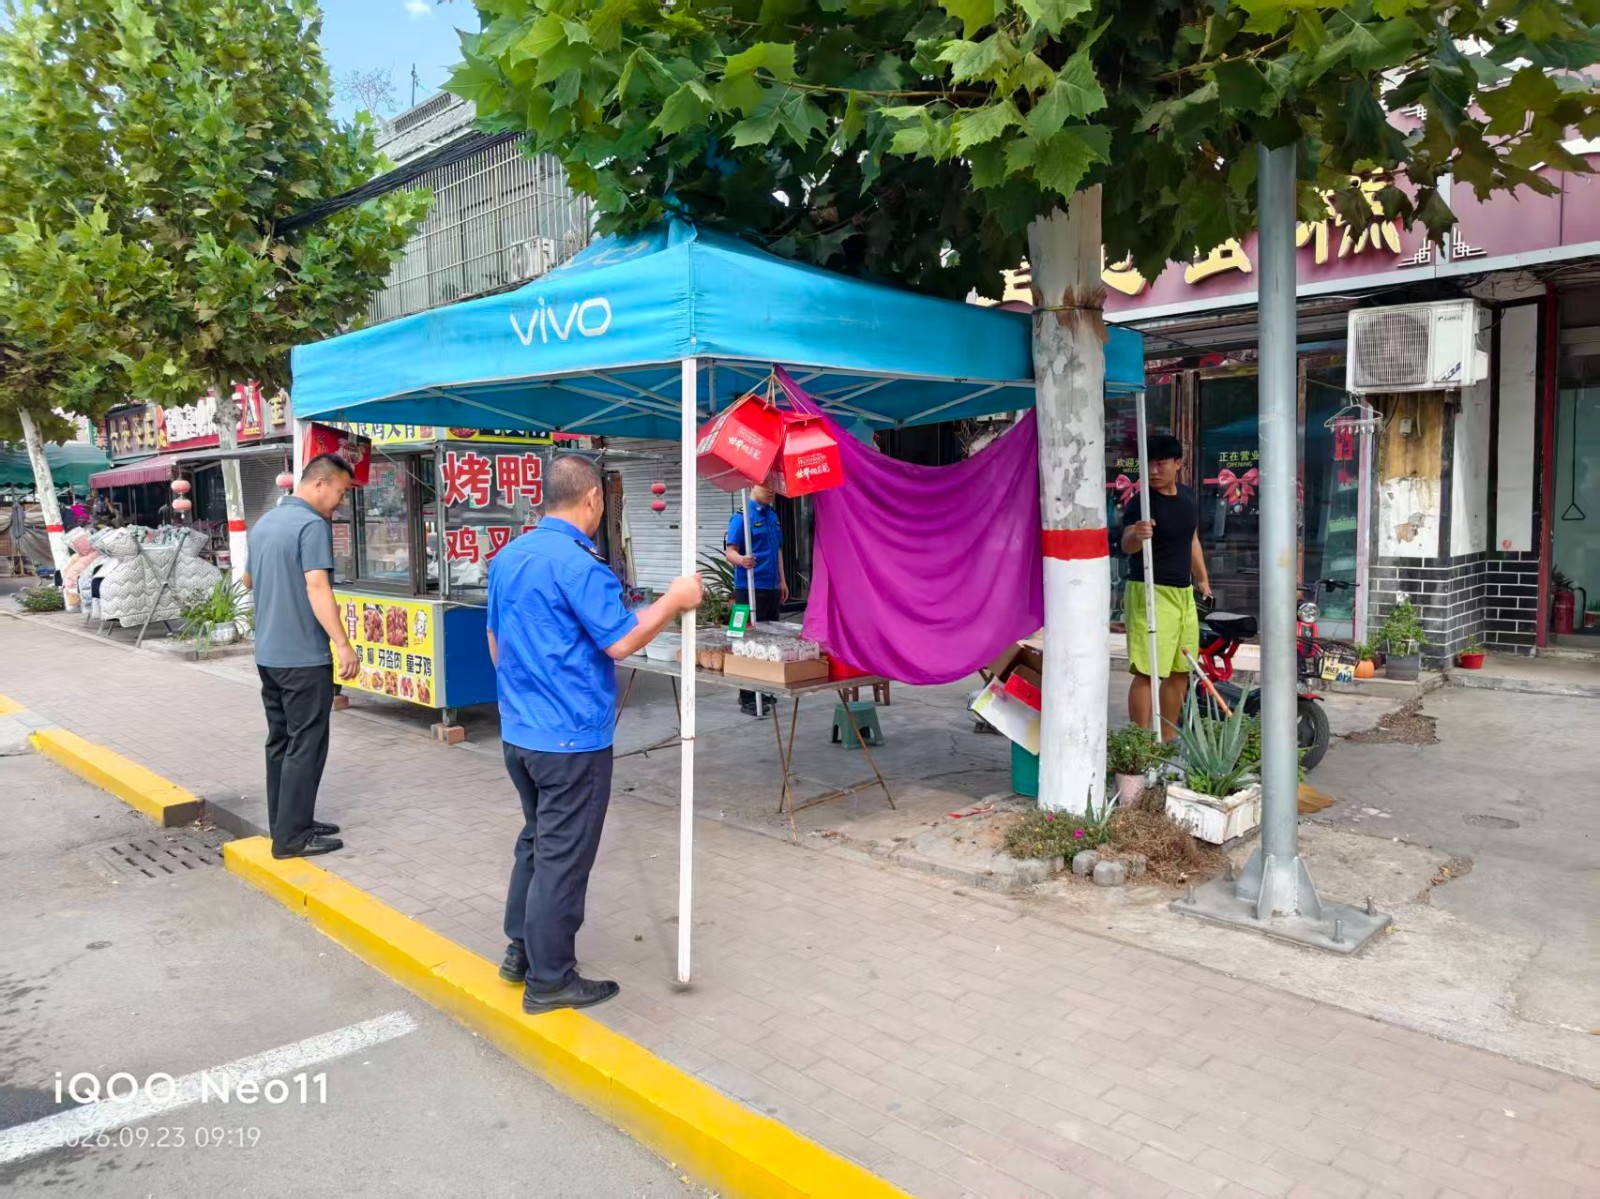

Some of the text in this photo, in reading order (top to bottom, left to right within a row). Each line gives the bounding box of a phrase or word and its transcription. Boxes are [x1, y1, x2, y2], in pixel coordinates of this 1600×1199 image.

[510, 296, 612, 346] vivo
[440, 452, 543, 506] 烤鸭
[443, 525, 538, 564] 鸡叉
[378, 648, 402, 670] 牙签肉
[406, 653, 432, 678] 童子鸡
